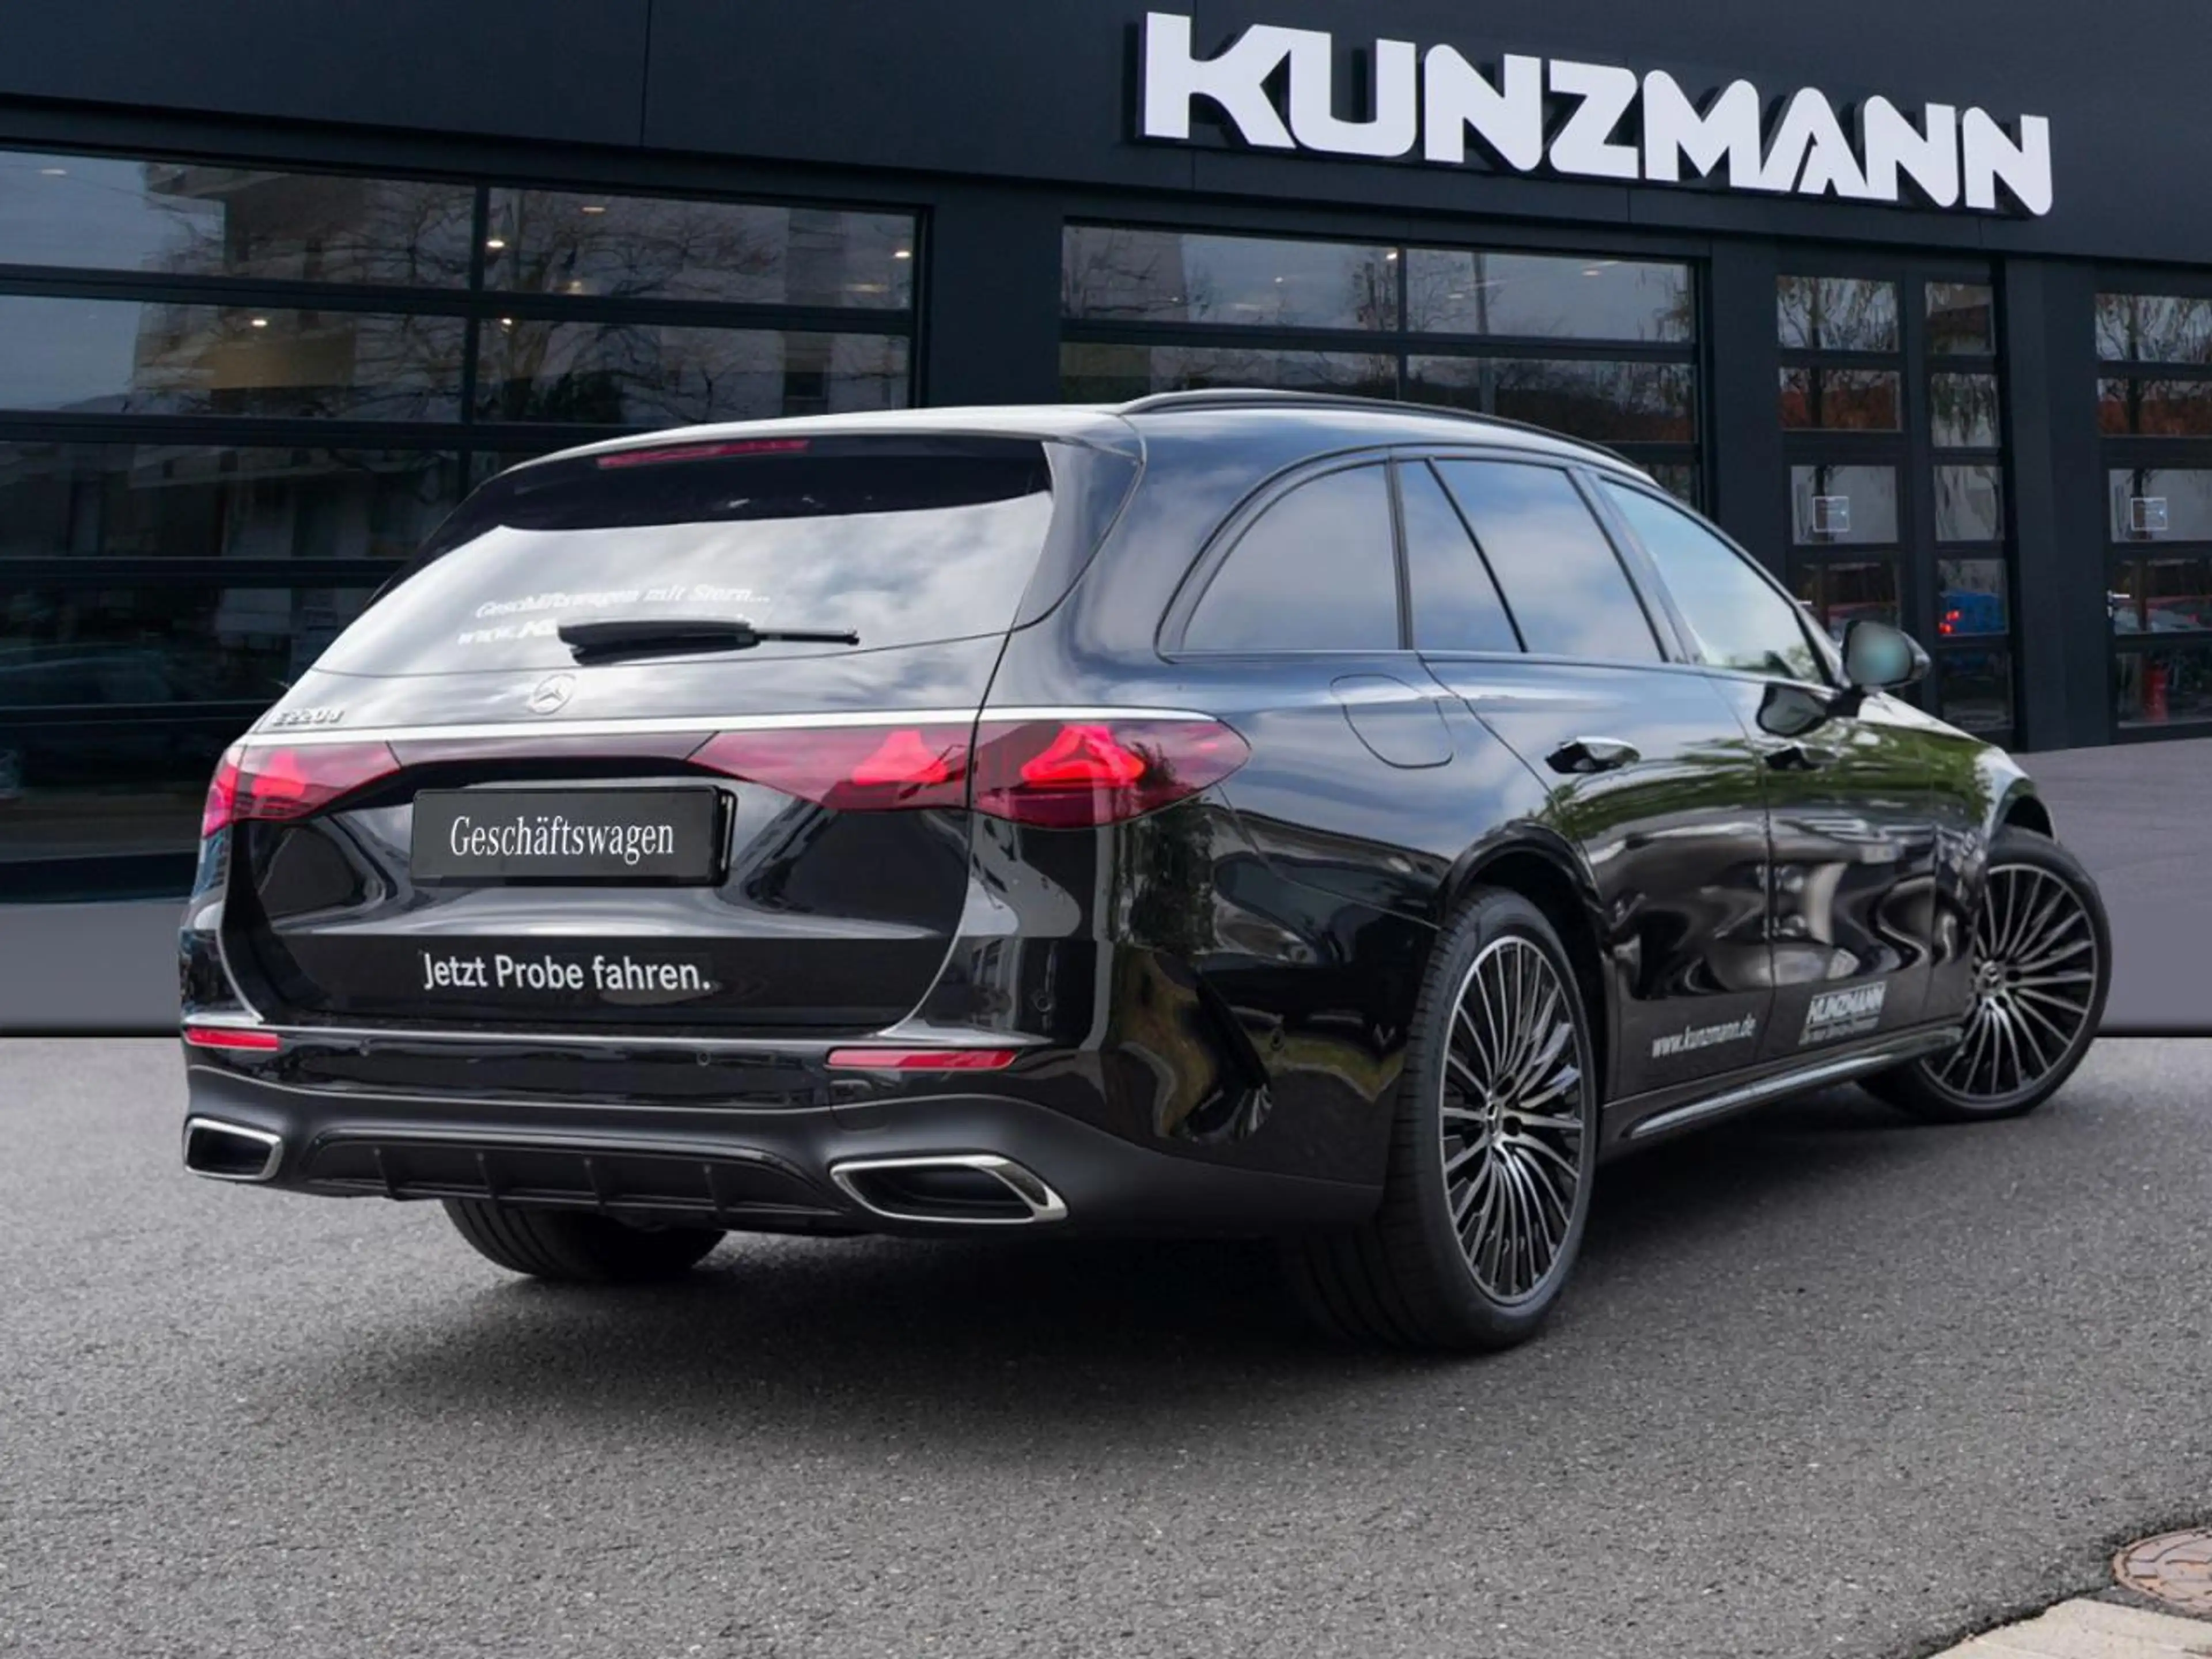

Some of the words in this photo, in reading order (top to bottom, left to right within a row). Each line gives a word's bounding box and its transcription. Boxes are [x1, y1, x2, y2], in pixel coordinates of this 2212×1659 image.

[1145, 12, 2053, 215] KUNZMANN
[450, 815, 674, 866] Geschäftswagen
[425, 953, 488, 990] Jetzt
[495, 955, 584, 989] Probe
[592, 955, 711, 990] fahren.
